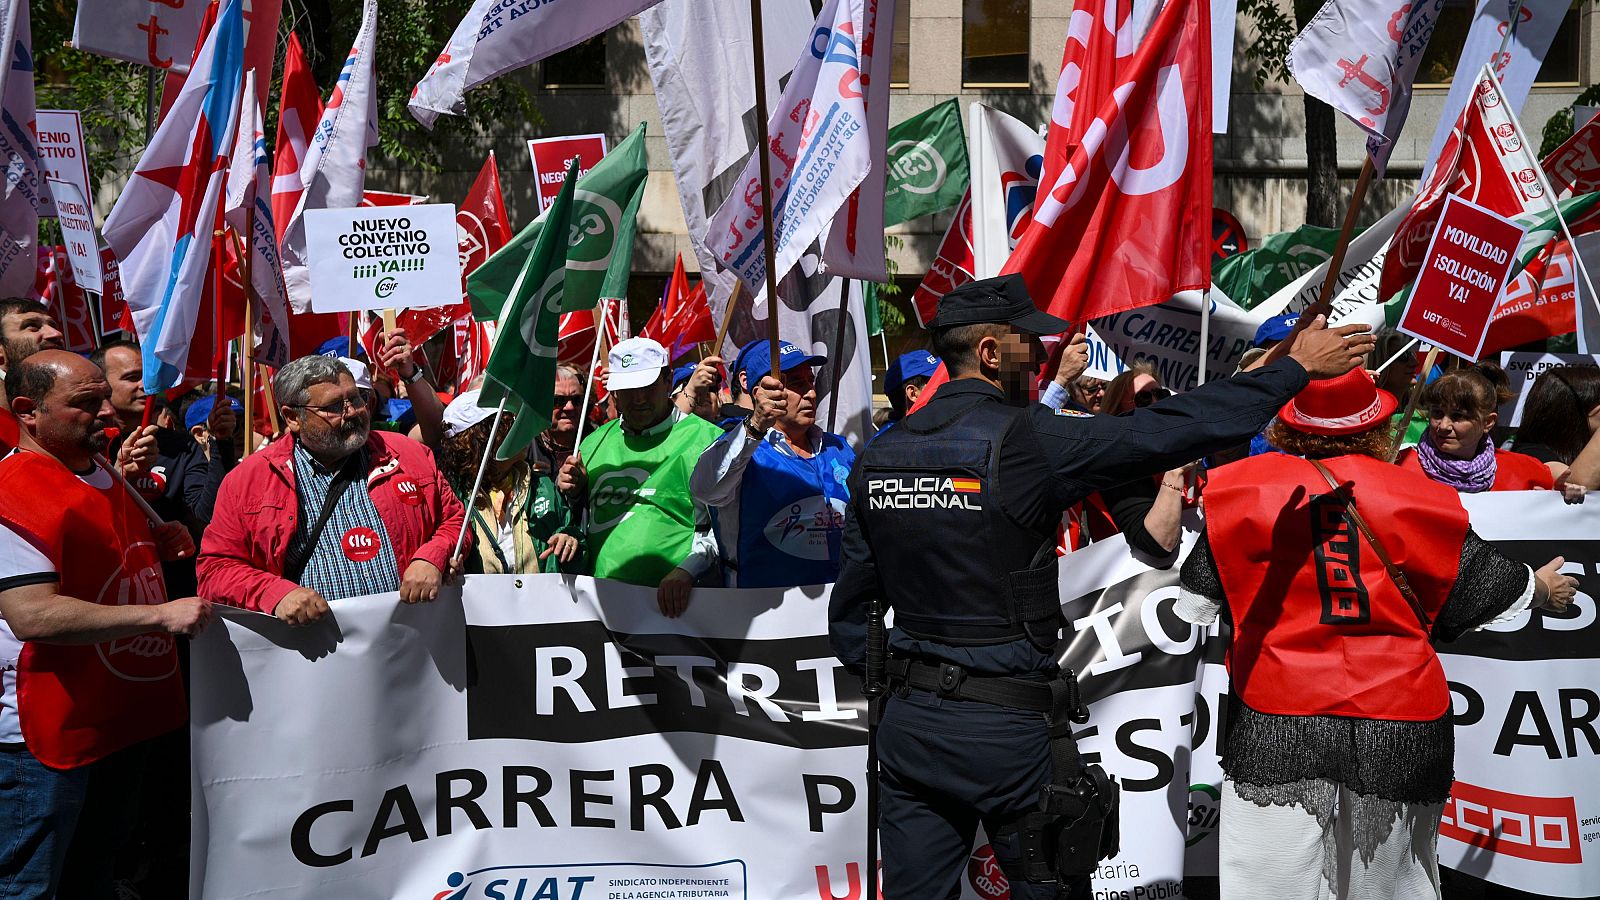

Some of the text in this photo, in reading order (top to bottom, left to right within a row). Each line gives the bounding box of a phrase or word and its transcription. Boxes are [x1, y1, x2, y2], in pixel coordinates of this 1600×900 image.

[0, 132, 38, 188] DICATO
[1, 164, 39, 215] AGENC
[353, 218, 411, 232] NUEVO
[339, 230, 427, 246] CONVENIO
[1443, 225, 1508, 265] MOVILIDAD
[343, 243, 430, 259] COLECTIVO
[1433, 254, 1497, 293] ¡SOLUCIÓN
[1448, 282, 1470, 304] YA!
[1422, 309, 1443, 325] UGT
[1122, 313, 1226, 361] CARREA
[1510, 361, 1533, 371] SVA
[869, 494, 982, 511] NACIONAL
[348, 534, 372, 548] CIG
[535, 641, 859, 723] RETRI
[290, 758, 746, 868] CARRERA
[1441, 797, 1571, 849] COO
[483, 876, 596, 900] SIAT
[608, 878, 729, 888] SINDICATO INDEPENDIENTE
[608, 889, 729, 900] DE LA AGENCIA TRIBUTARIA
